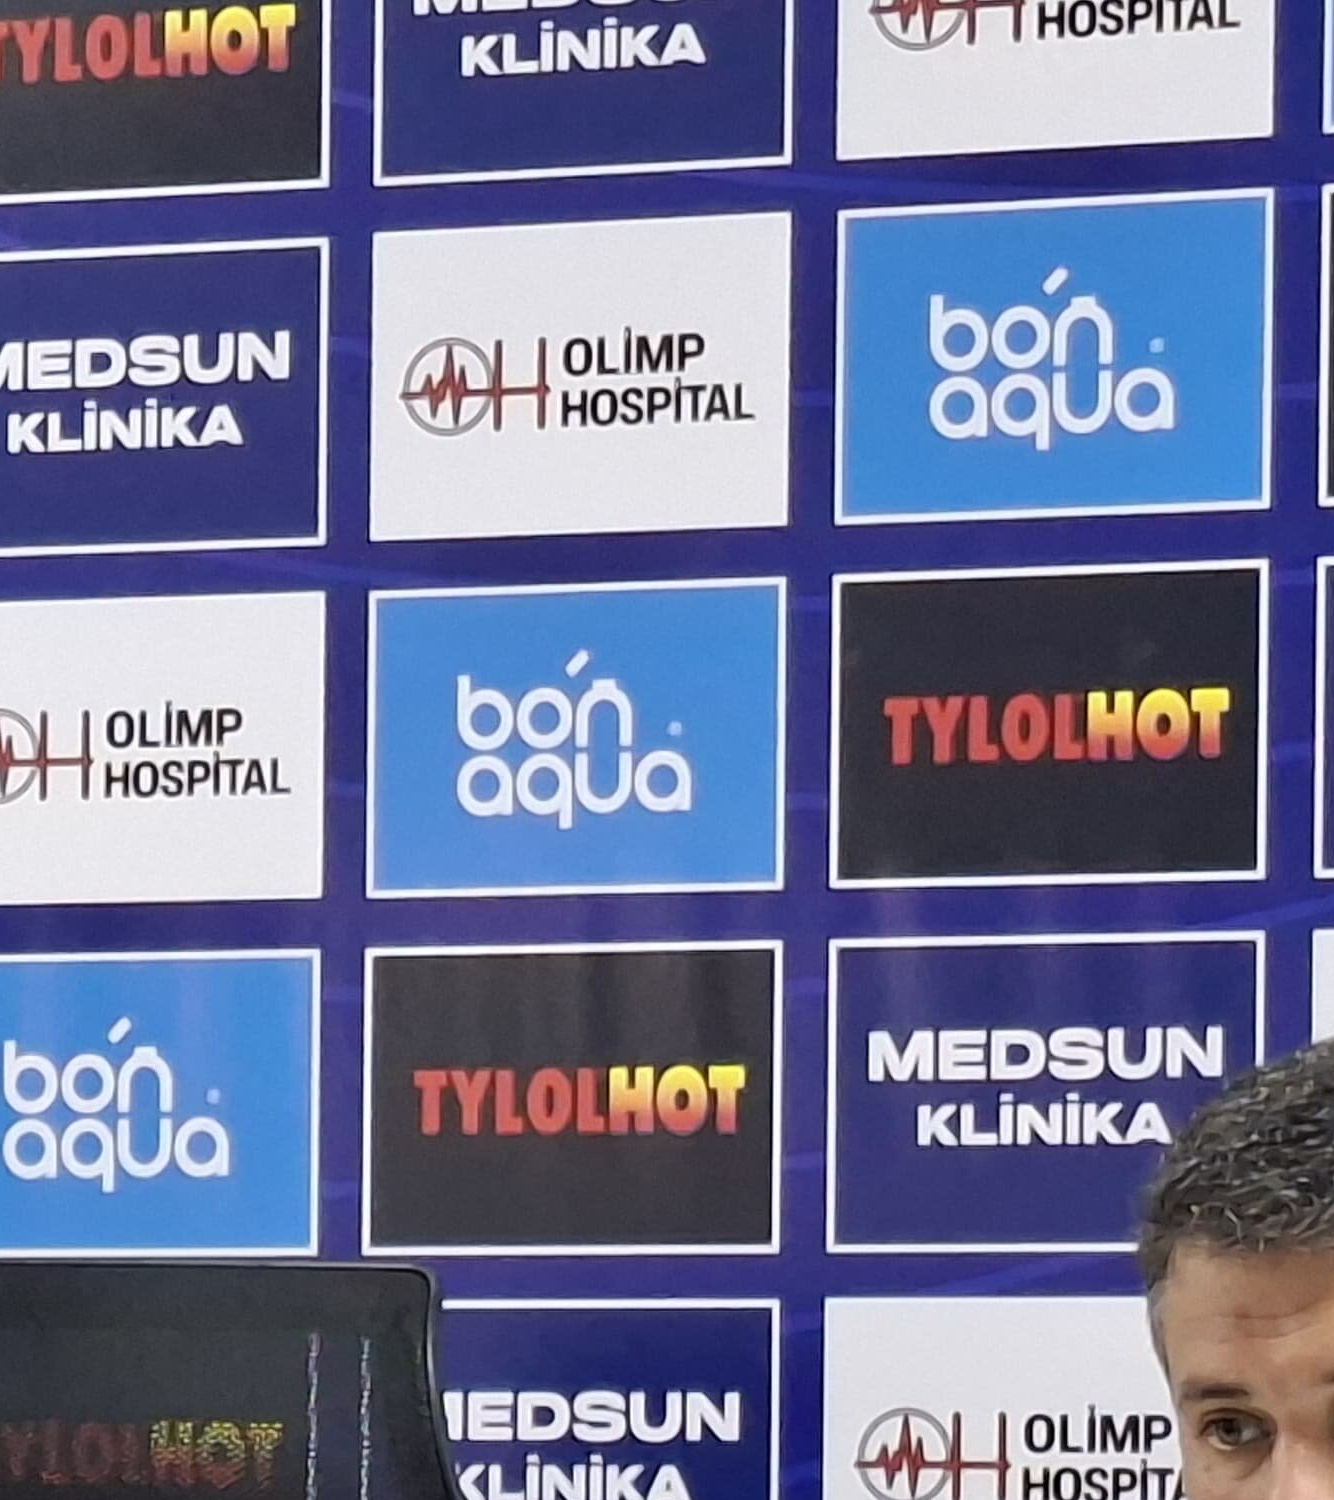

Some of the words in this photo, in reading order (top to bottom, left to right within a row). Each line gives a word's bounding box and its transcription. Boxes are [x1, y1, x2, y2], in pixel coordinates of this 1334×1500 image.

[929, 367, 1176, 452] aqua
[457, 748, 692, 829] aqua
[868, 1025, 1224, 1083] MEDSUN
[3, 1114, 232, 1193] aqua
